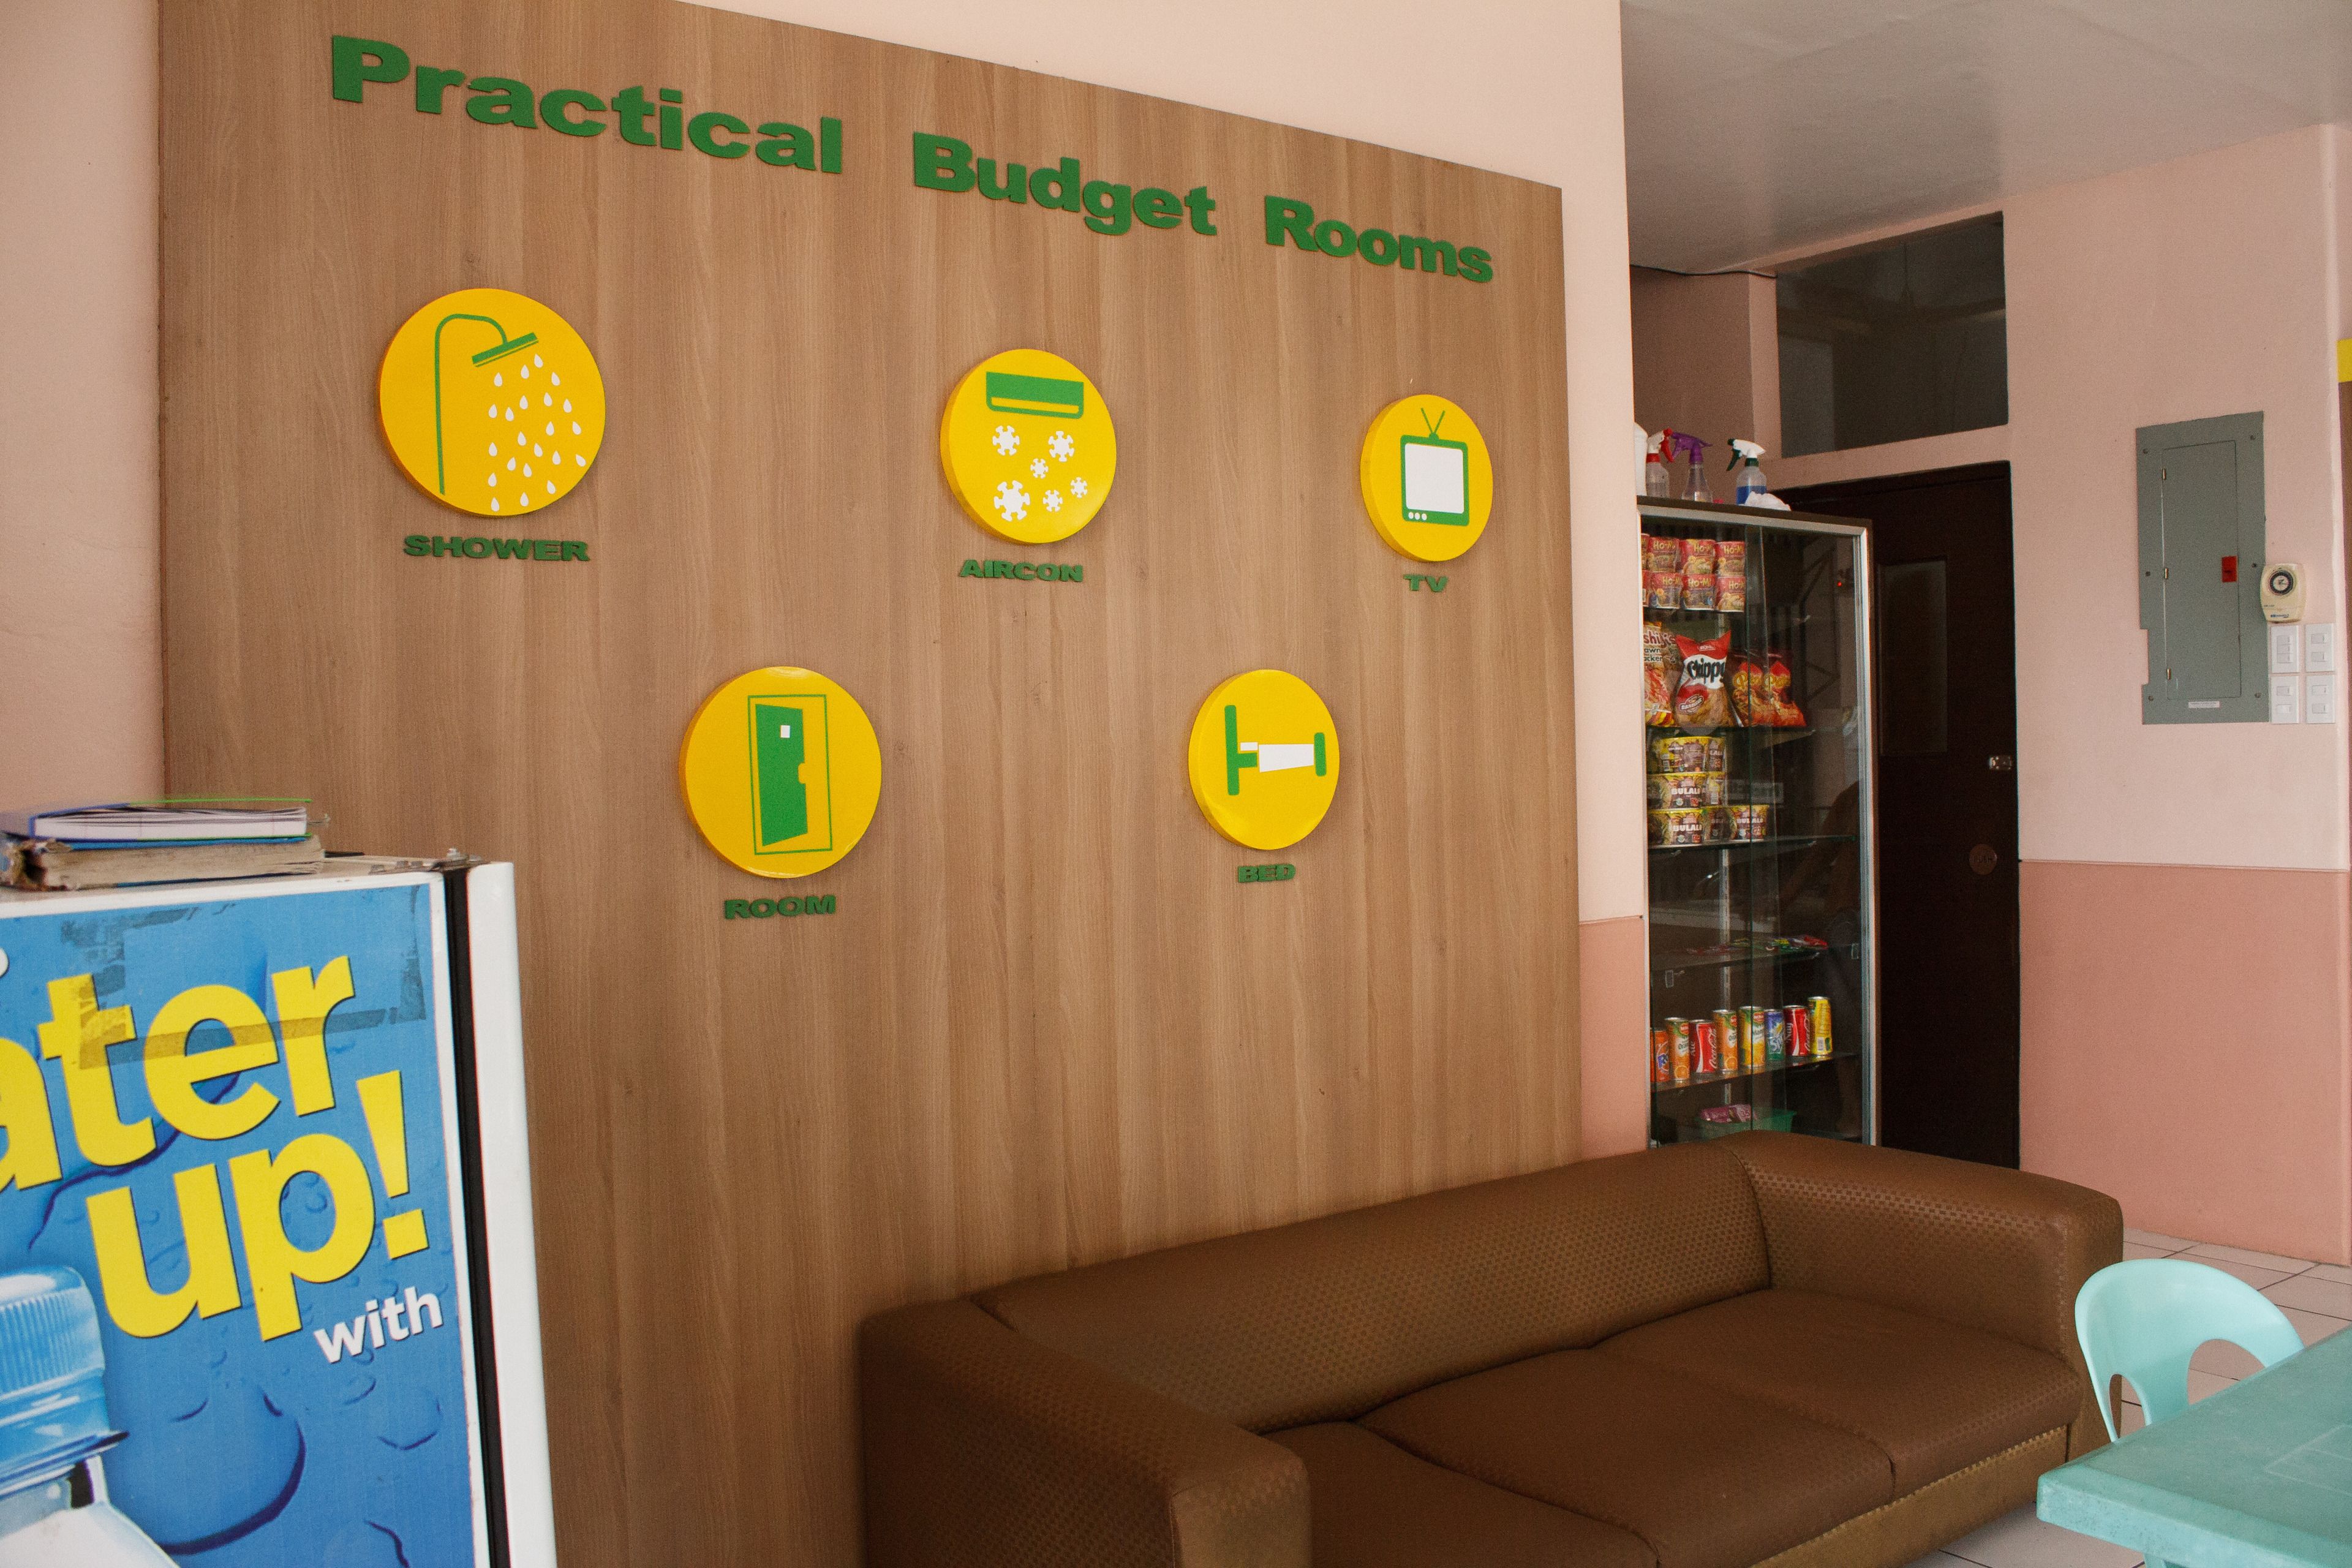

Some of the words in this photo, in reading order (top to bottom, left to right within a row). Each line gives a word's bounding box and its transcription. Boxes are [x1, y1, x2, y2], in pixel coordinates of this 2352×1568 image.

[332, 35, 842, 174] Practical
[913, 132, 1217, 235] Budget
[1265, 195, 1493, 283] Rooms
[404, 535, 590, 561] SHOWER
[959, 559, 1083, 582] AIRCON
[1403, 574, 1448, 592] TV
[1643, 630, 1660, 644] shi
[1237, 864, 1296, 883] BED
[724, 895, 836, 919] ROOM
[86, 1070, 429, 1341] up!
[314, 1286, 443, 1363] with
